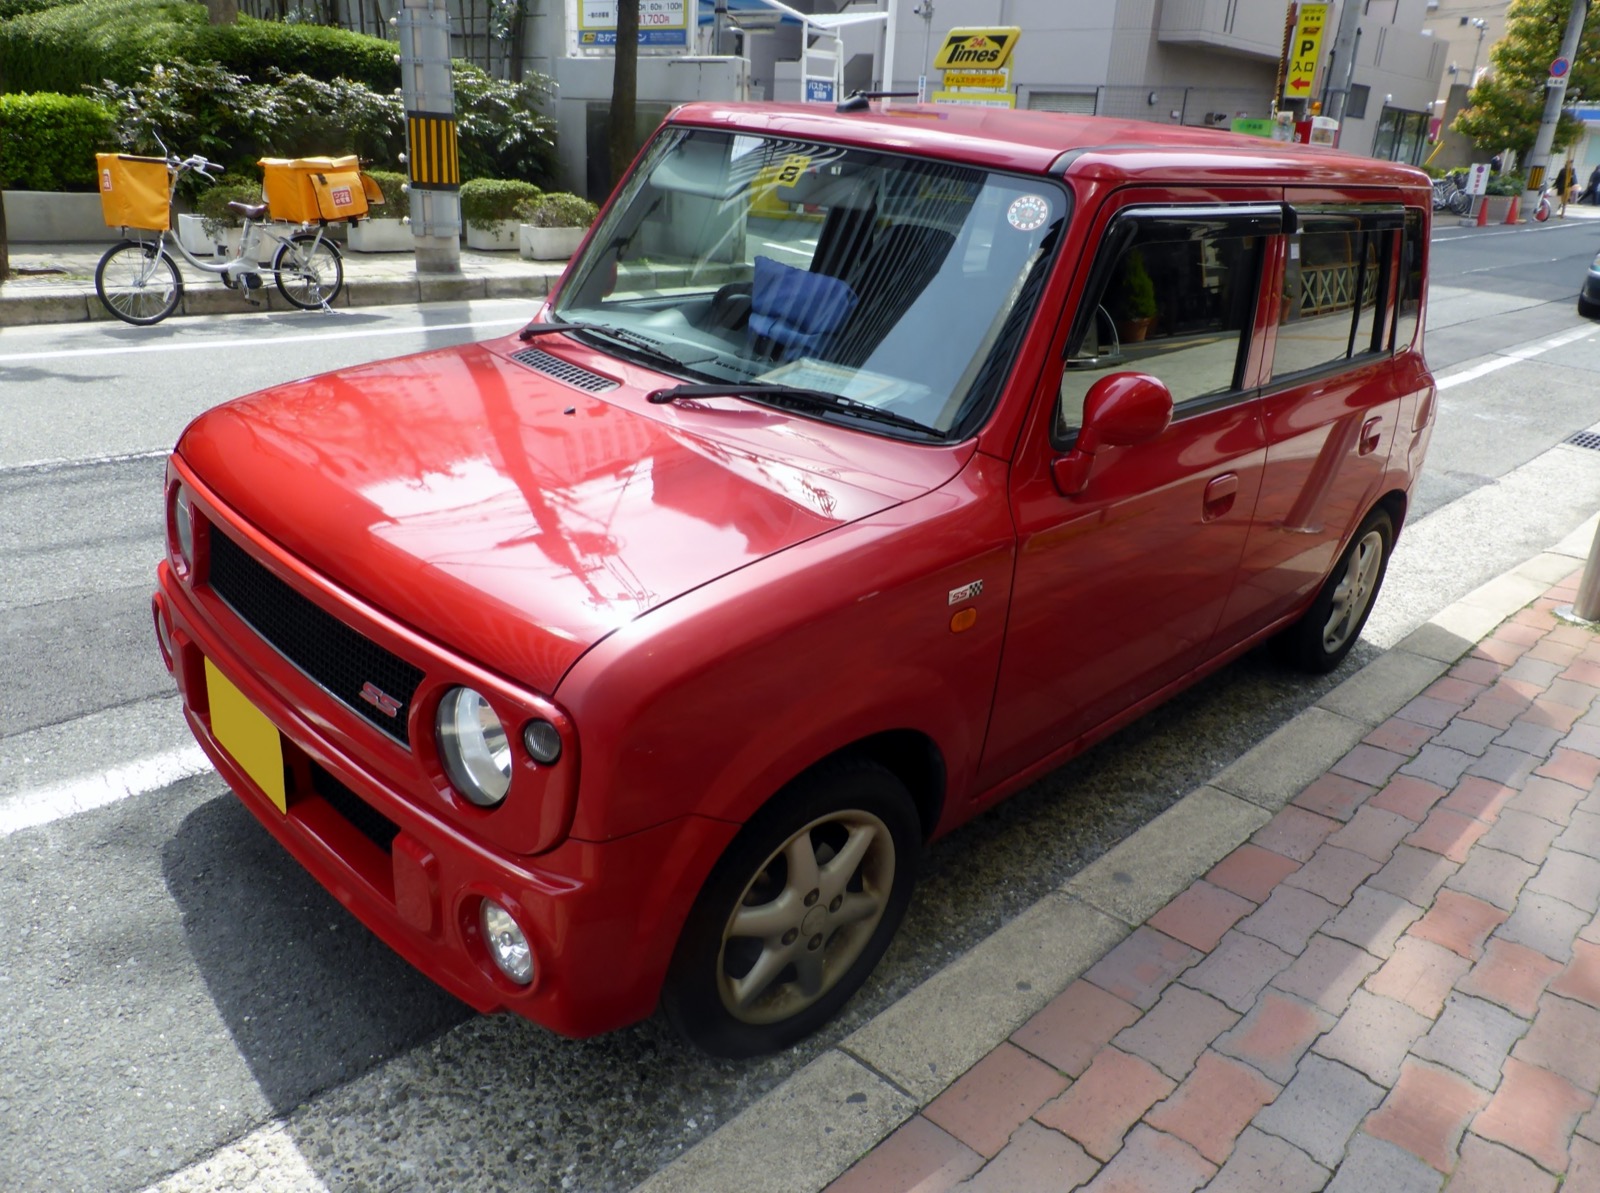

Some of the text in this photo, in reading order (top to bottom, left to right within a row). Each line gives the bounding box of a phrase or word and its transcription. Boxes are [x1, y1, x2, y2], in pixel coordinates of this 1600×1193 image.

[946, 43, 1000, 64] Times
[1300, 40, 1315, 57] P
[1293, 61, 1315, 73] 入口
[358, 680, 404, 718] SS
